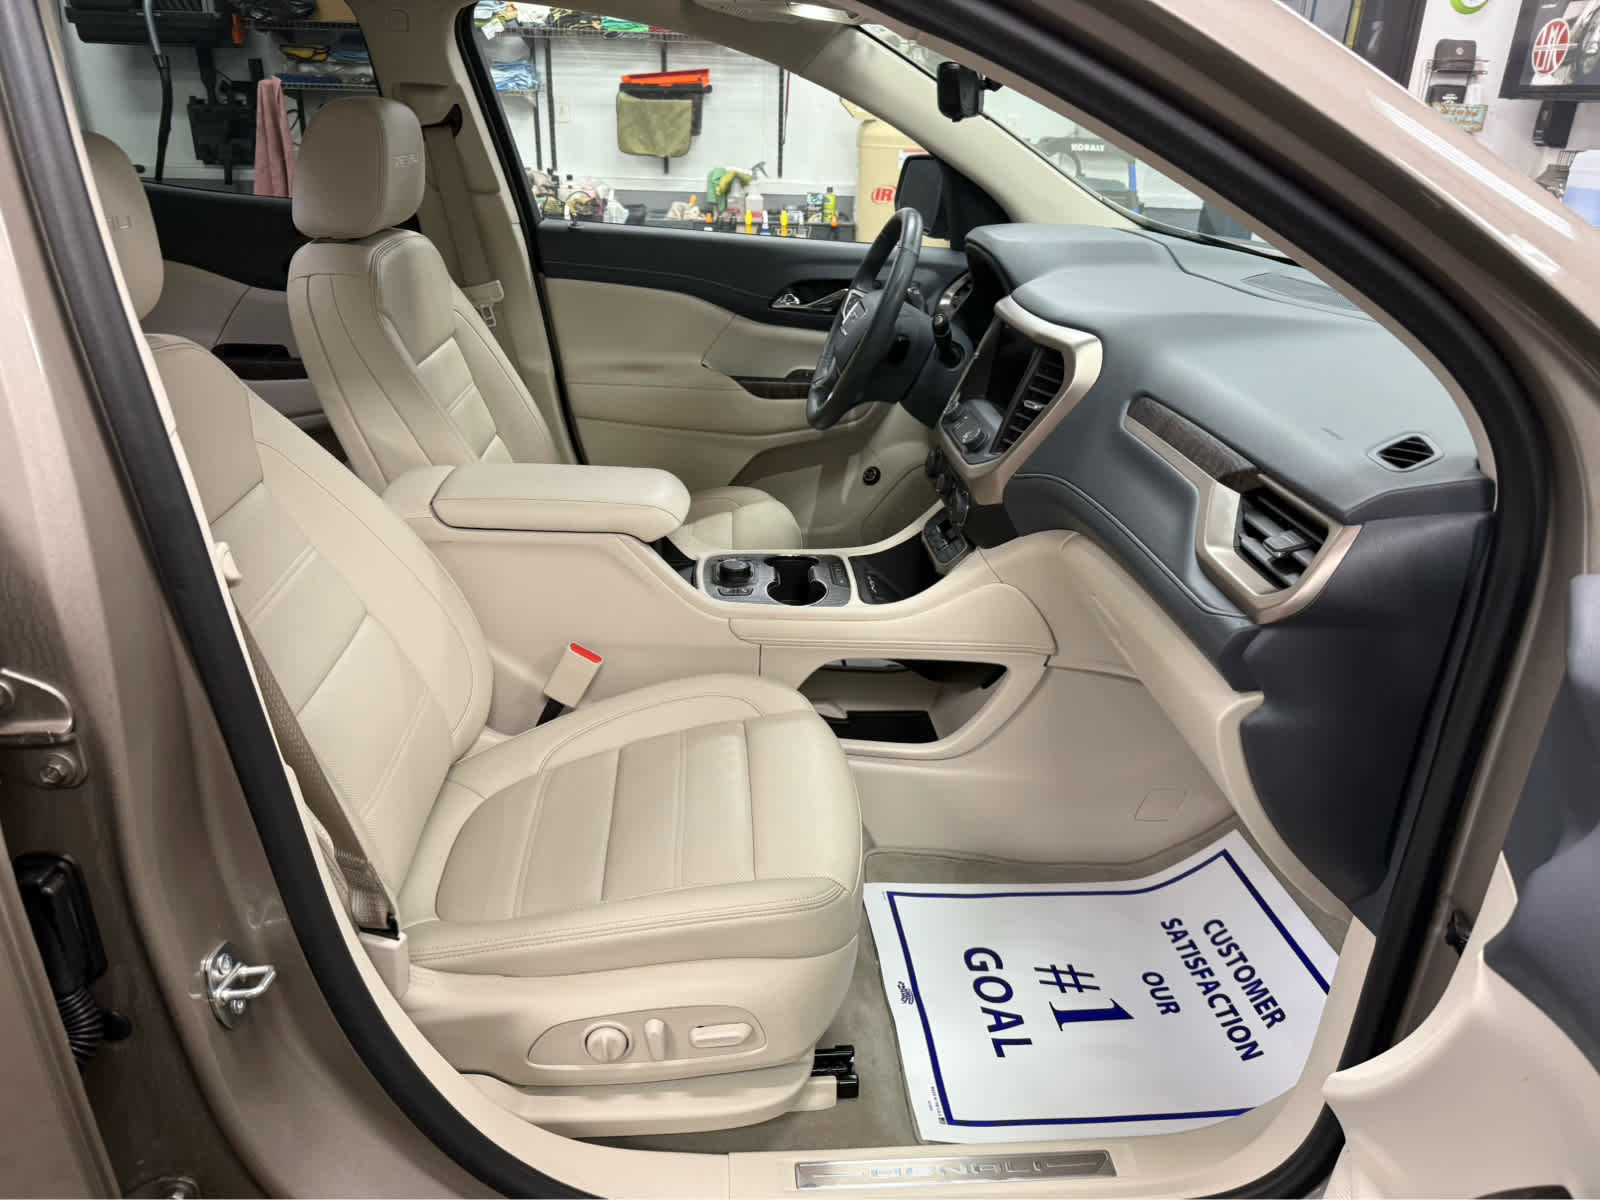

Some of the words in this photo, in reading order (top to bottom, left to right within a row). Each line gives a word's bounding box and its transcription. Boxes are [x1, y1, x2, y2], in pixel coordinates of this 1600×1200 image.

[1071, 143, 1104, 152] KOBALT
[874, 187, 894, 203] IR
[963, 947, 1033, 1058] GOAL
[1033, 963, 1135, 1032] #1
[1141, 971, 1181, 1016] OUR
[1160, 917, 1265, 1062] SATISFACTION
[1203, 919, 1286, 1029] CUSTOMER
